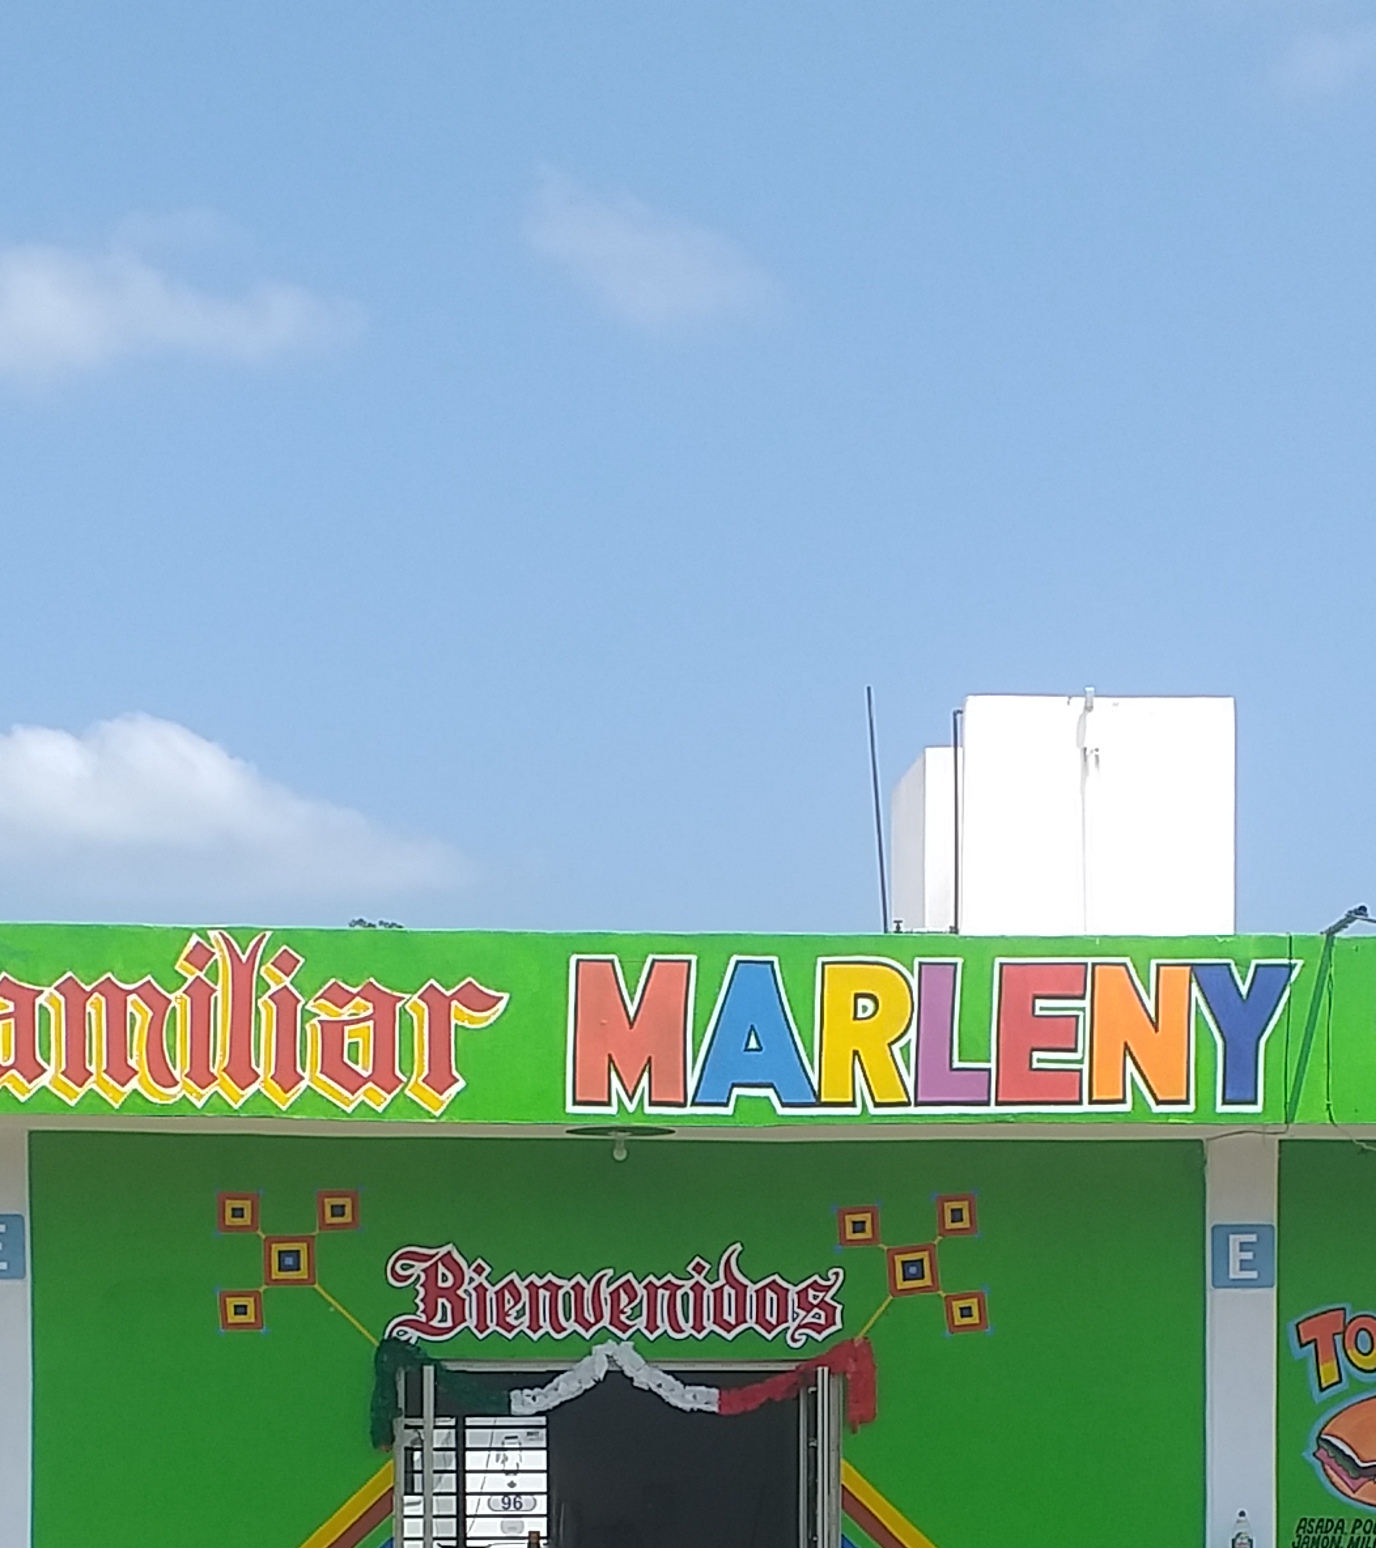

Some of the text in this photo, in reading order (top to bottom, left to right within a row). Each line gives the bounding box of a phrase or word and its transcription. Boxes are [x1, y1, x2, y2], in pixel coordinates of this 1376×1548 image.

[566, 954, 1302, 1114] MARLENY
[1229, 1233, 1261, 1280] E
[385, 1242, 844, 1349] Bienvenidos
[501, 1495, 523, 1511] 96
